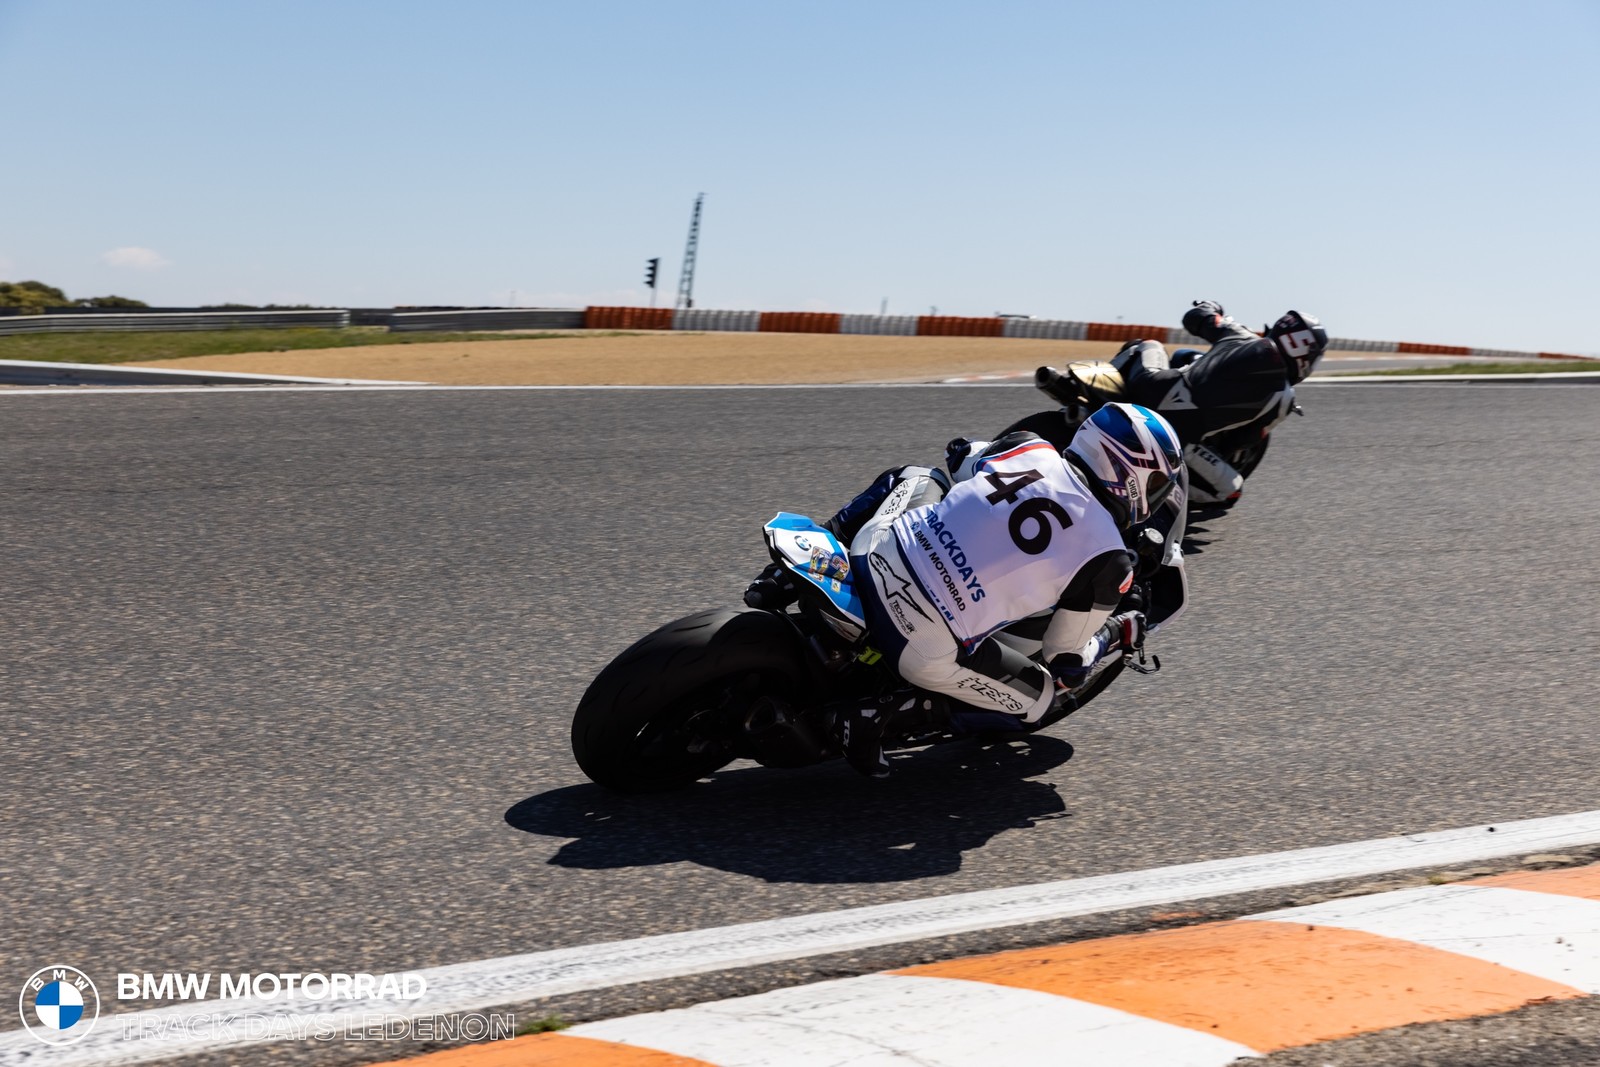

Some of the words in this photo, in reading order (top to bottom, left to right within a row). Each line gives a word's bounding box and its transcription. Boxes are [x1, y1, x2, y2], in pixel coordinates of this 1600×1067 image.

[984, 468, 1074, 555] 46
[1127, 479, 1138, 499] SHOEI
[914, 530, 933, 551] BMW
[928, 551, 966, 612] MOTORRAD
[924, 510, 986, 603] TRACKDAYS
